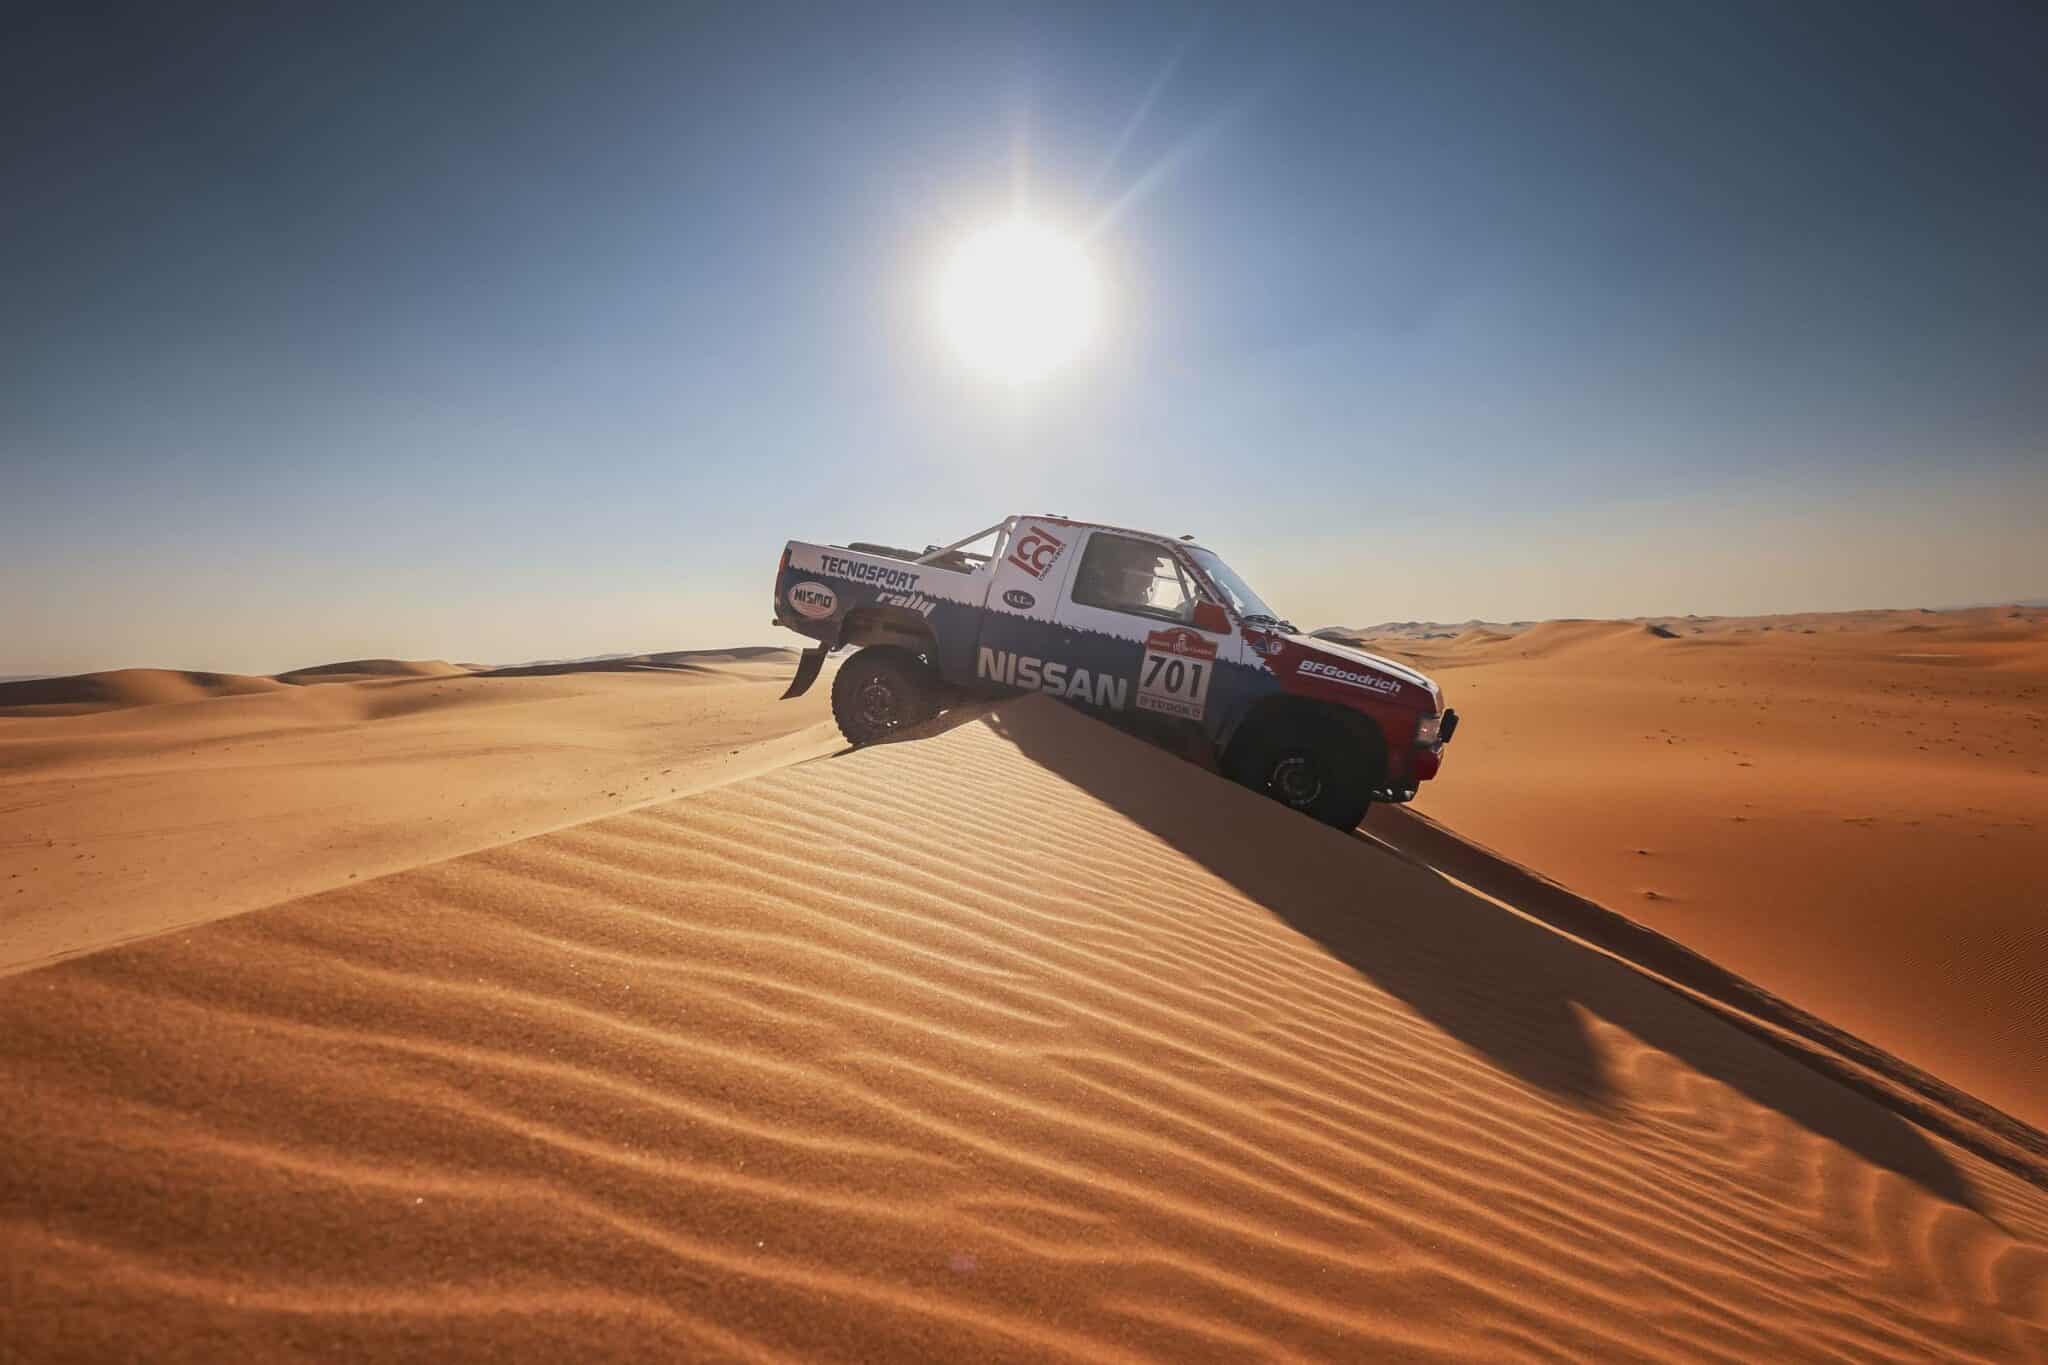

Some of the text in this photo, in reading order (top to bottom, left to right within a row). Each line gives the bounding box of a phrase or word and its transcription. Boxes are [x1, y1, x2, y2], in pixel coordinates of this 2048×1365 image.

[821, 555, 920, 589] TECNOSPORT
[794, 589, 833, 608] NISMO
[876, 592, 936, 618] rally
[978, 647, 1128, 712] NISSAN
[1144, 655, 1202, 698] 701
[1299, 659, 1402, 693] BFGoodrich
